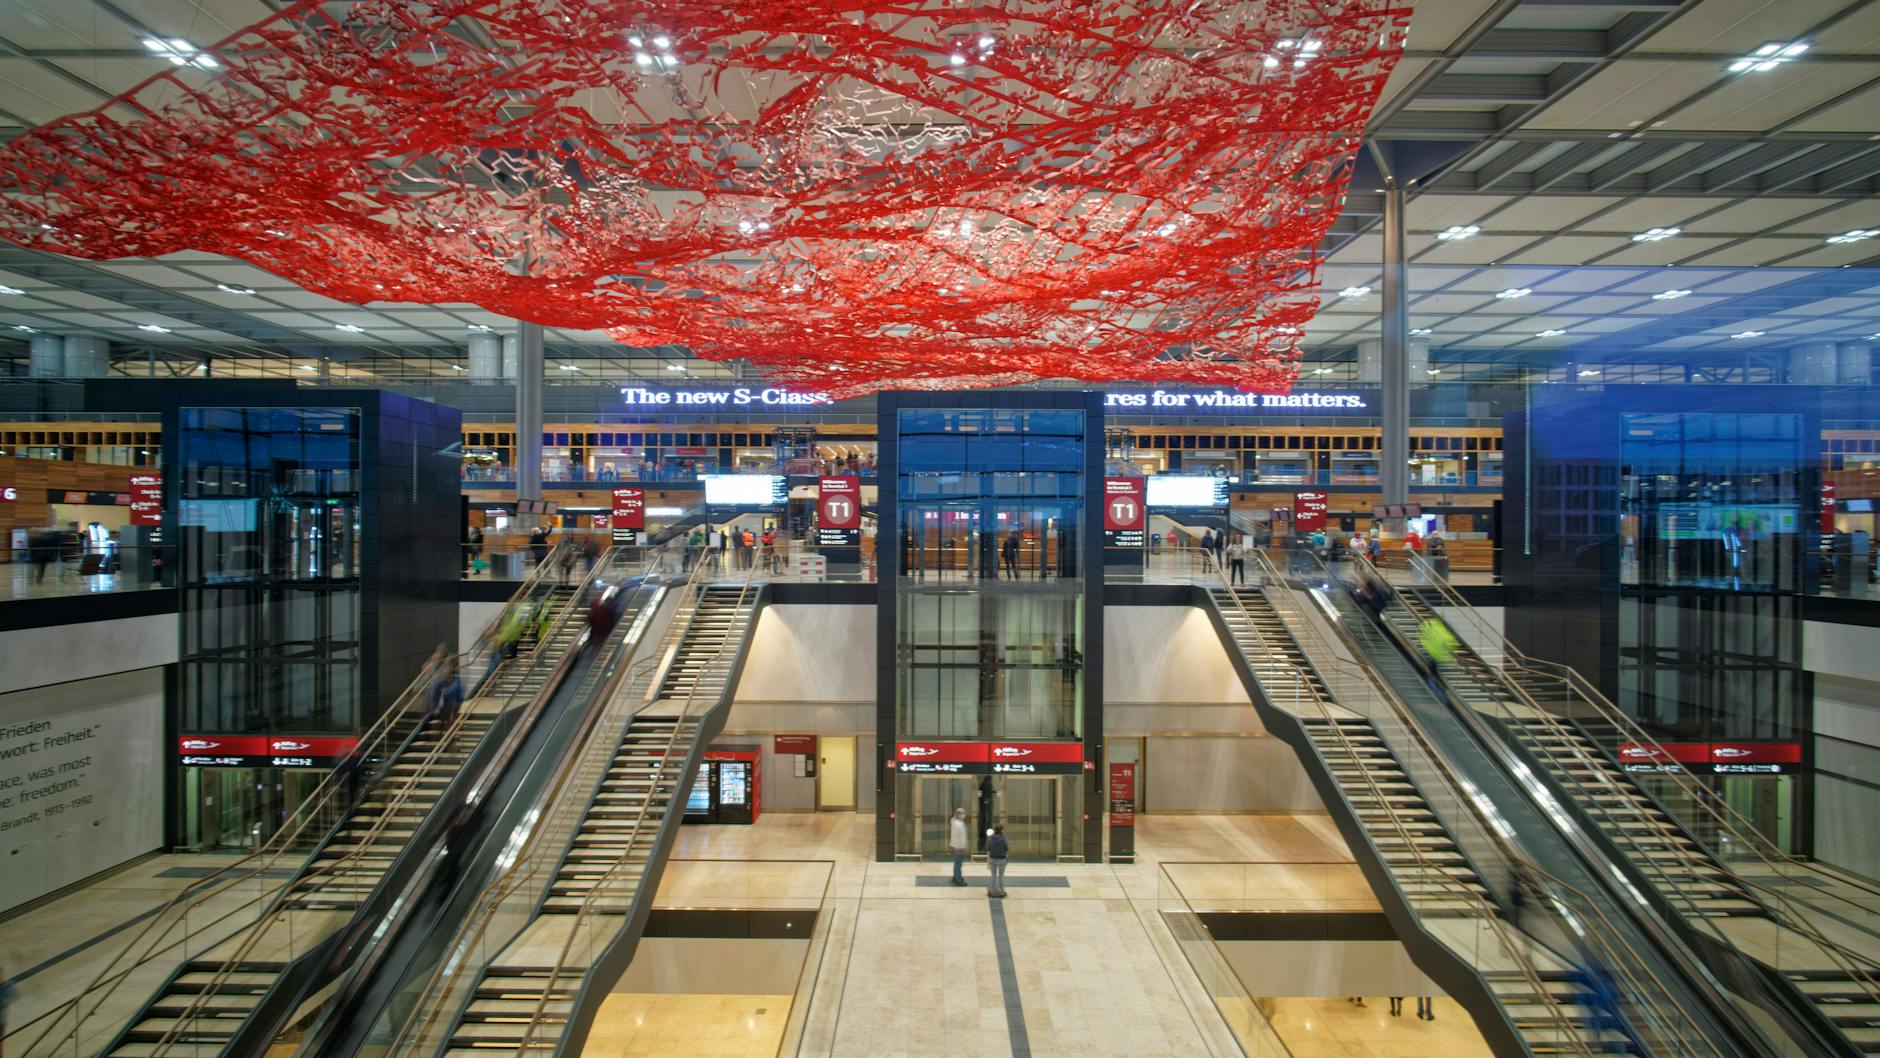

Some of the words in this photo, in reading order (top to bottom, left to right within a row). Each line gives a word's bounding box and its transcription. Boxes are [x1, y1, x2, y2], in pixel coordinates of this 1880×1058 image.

[621, 388, 670, 404] The
[676, 392, 730, 404] new
[1152, 390, 1191, 406] for
[1193, 391, 1257, 407] what
[1262, 393, 1367, 408] matters.
[4, 488, 17, 500] 6
[828, 502, 849, 518] T1
[1113, 503, 1134, 519] T1
[0, 721, 51, 741] Frieden
[28, 766, 55, 782] was
[59, 756, 92, 773] most
[0, 797, 14, 810] e:
